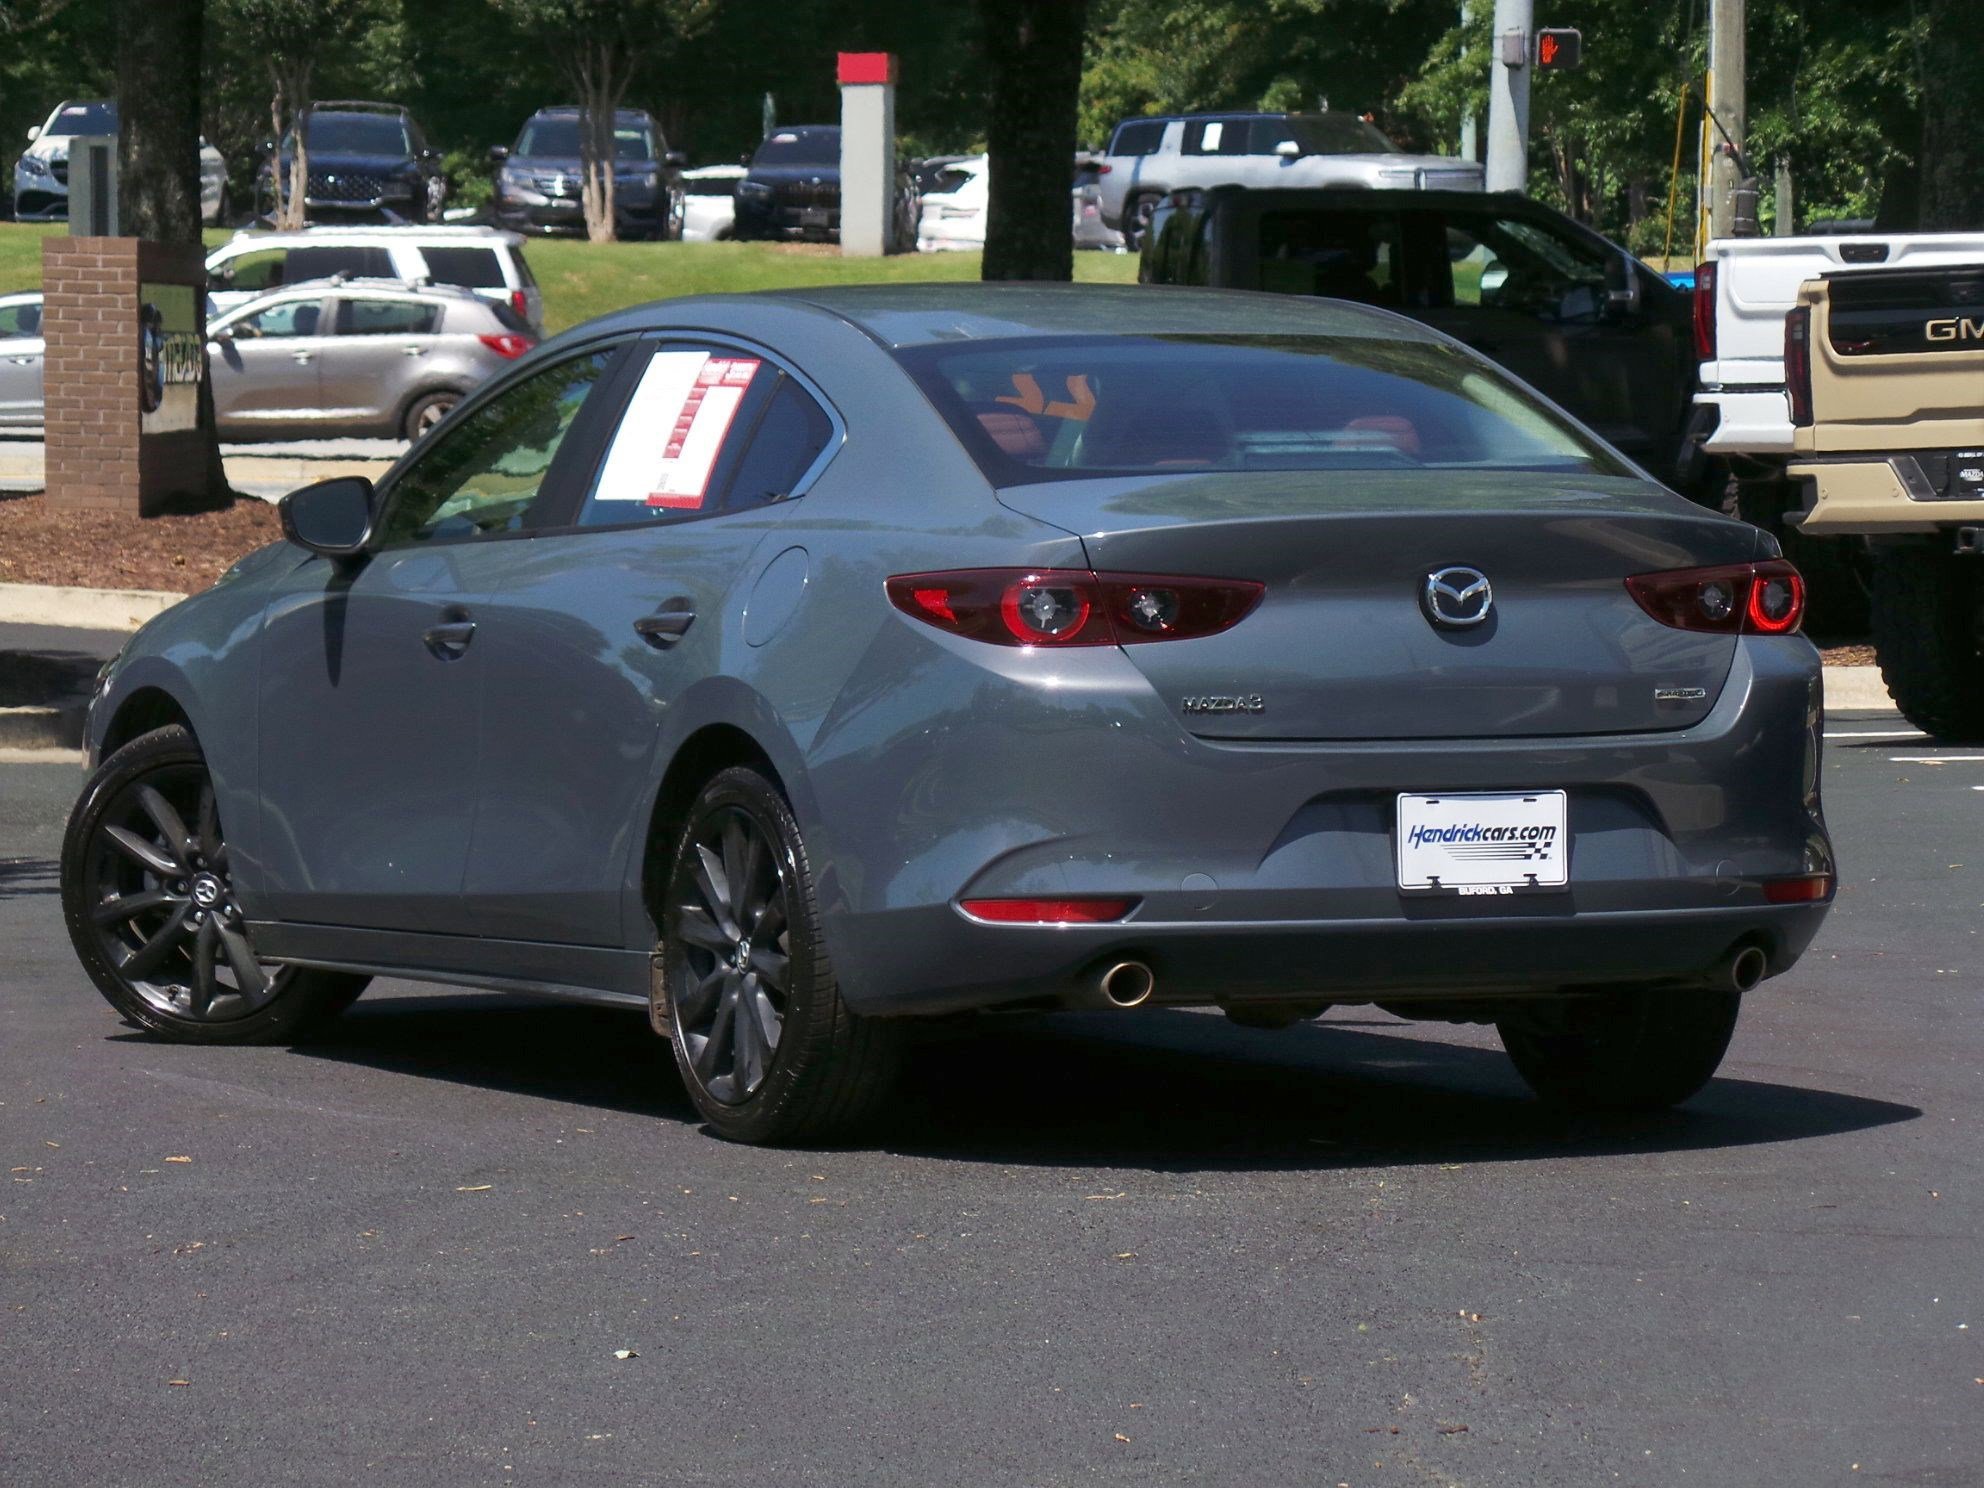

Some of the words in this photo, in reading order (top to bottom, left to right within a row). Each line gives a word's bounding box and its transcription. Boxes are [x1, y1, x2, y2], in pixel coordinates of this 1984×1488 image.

[1182, 694, 1264, 713] MAZDA3
[1408, 823, 1557, 849] Hendrickcars.com
[1499, 886, 1514, 895] GA
